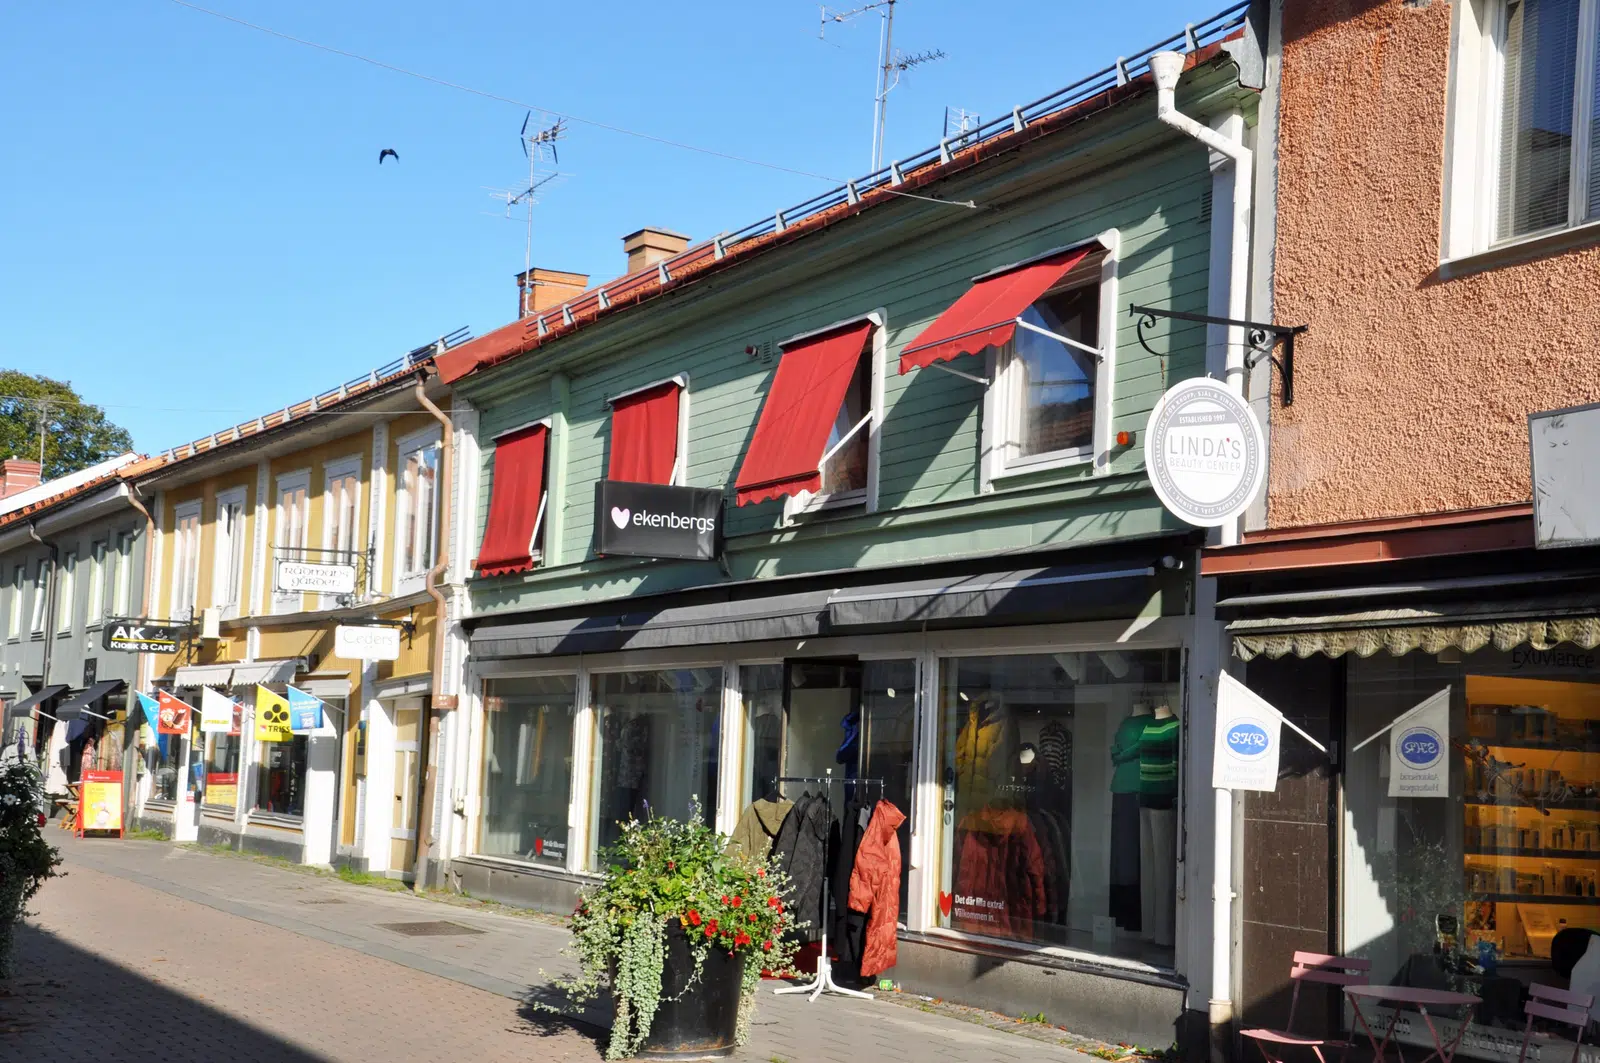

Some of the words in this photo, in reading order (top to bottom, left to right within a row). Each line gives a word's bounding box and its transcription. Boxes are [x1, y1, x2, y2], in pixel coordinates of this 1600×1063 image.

[1179, 415, 1213, 424] ESTABLISHED
[1170, 434, 1241, 460] LINDA'S
[1169, 457, 1203, 469] BEAUTY
[1206, 459, 1241, 472] CENTER
[632, 509, 715, 534] ekenbergs
[112, 625, 145, 640] AK
[141, 642, 149, 651] &
[268, 725, 290, 734] TRISS
[1229, 731, 1265, 747] SHR
[954, 894, 965, 905] Det
[966, 896, 976, 906] där
[987, 900, 1005, 910] extra!
[954, 907, 988, 920] Välkommen
